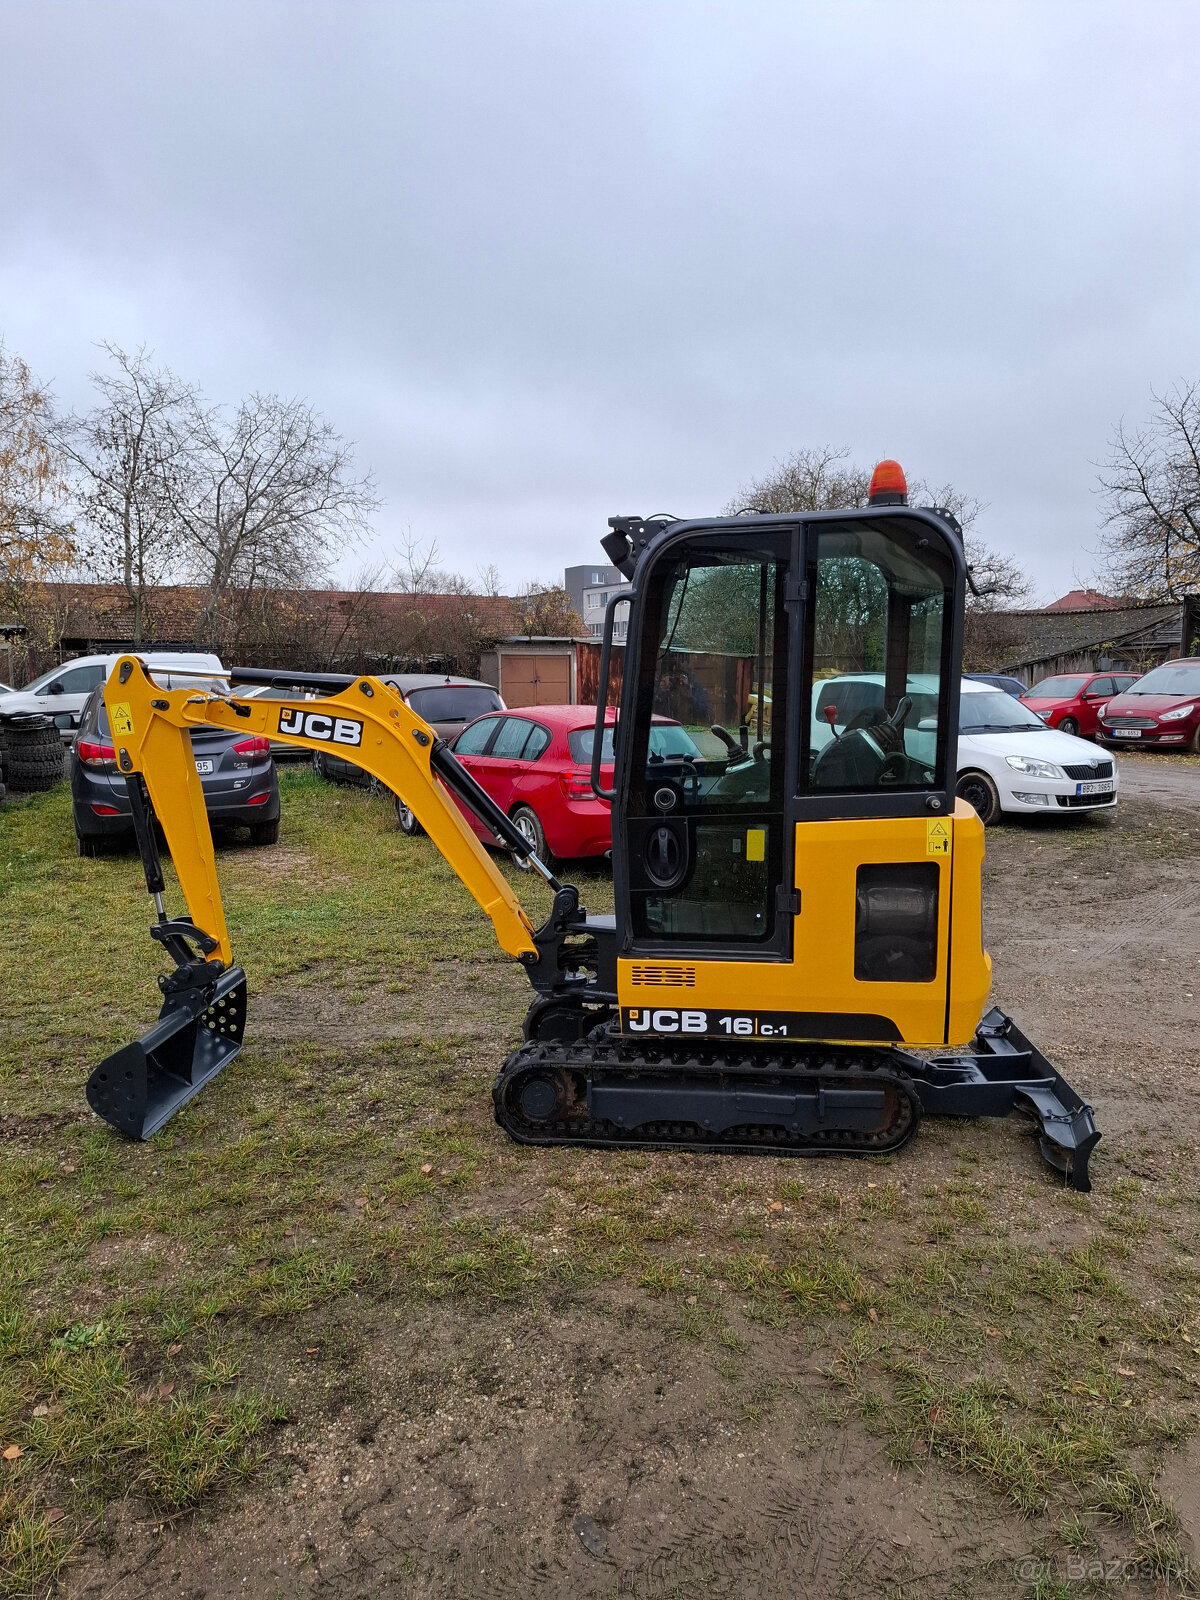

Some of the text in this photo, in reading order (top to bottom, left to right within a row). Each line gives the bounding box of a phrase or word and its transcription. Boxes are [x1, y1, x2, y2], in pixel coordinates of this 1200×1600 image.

[280, 711, 362, 745] JCB
[197, 761, 209, 771] 95
[629, 1010, 708, 1033] JCB
[718, 1016, 753, 1035] 16
